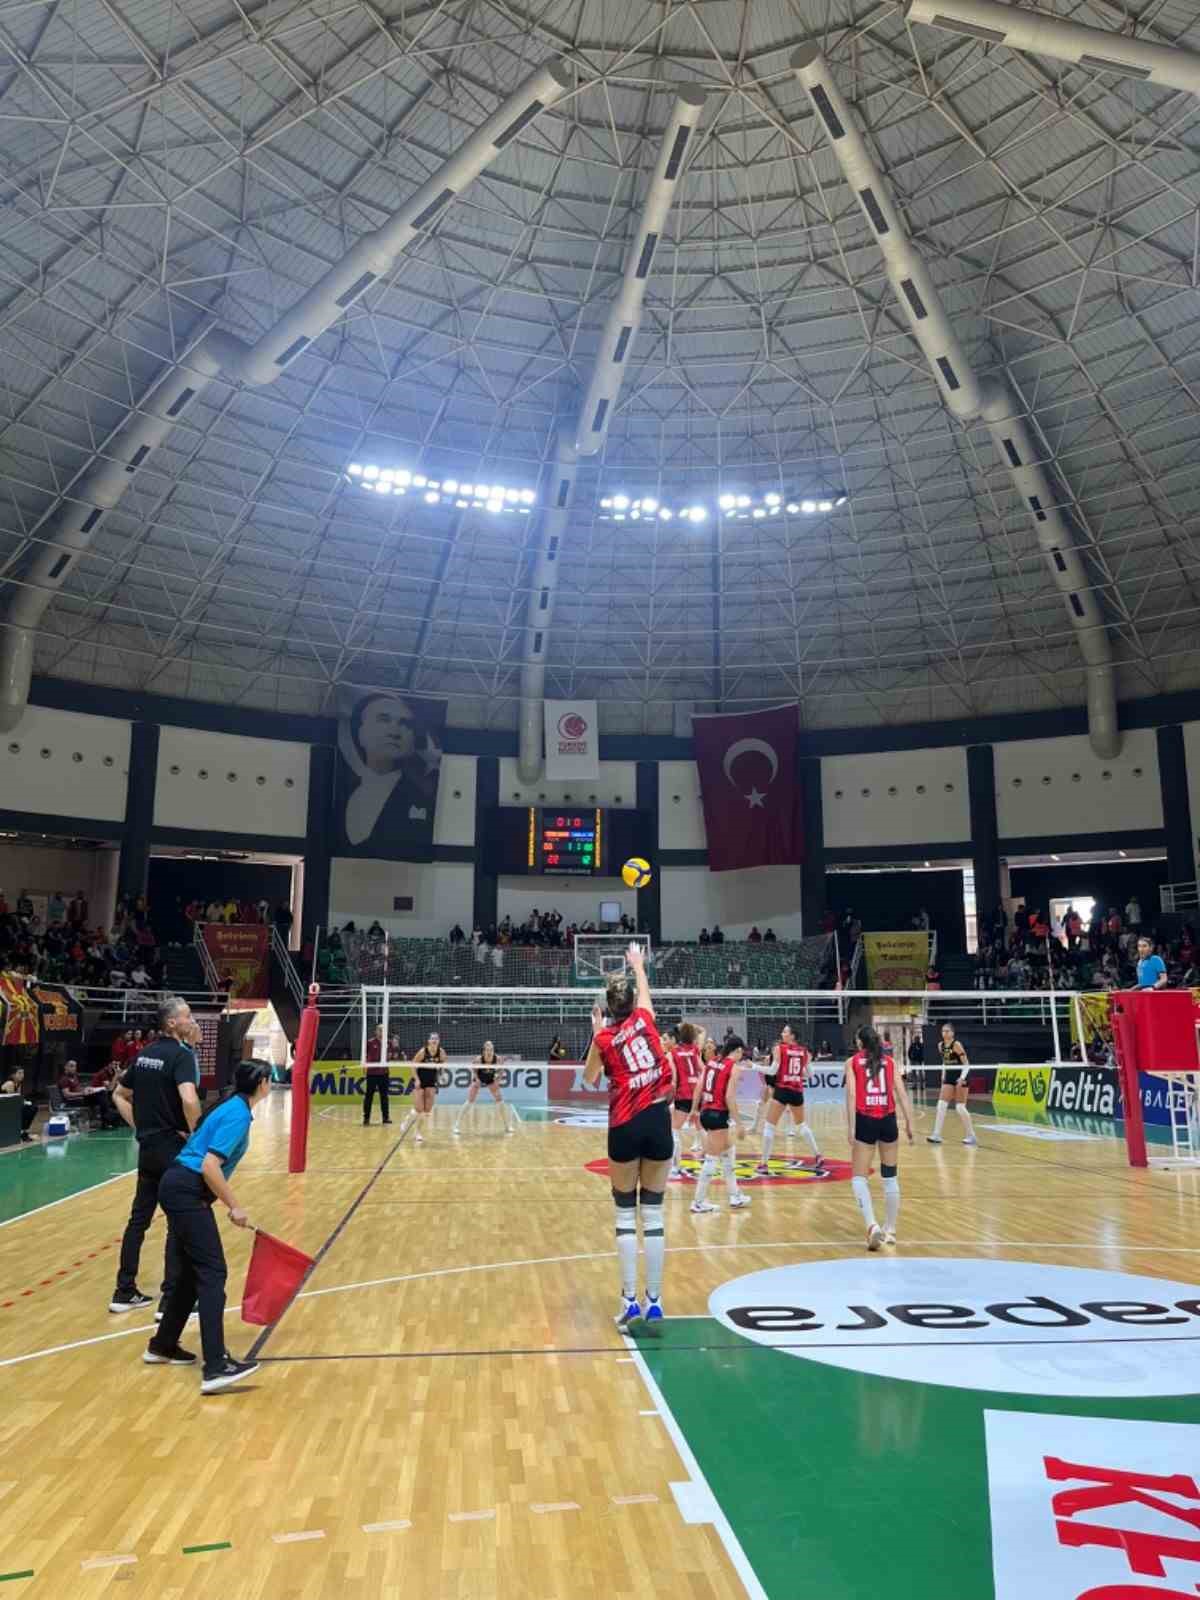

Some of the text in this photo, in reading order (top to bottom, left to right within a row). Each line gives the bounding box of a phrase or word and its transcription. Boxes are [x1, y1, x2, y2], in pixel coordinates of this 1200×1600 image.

[623, 1034, 656, 1072] 18
[1047, 1068, 1115, 1115] heltia
[1042, 1455, 1200, 1600] KF
